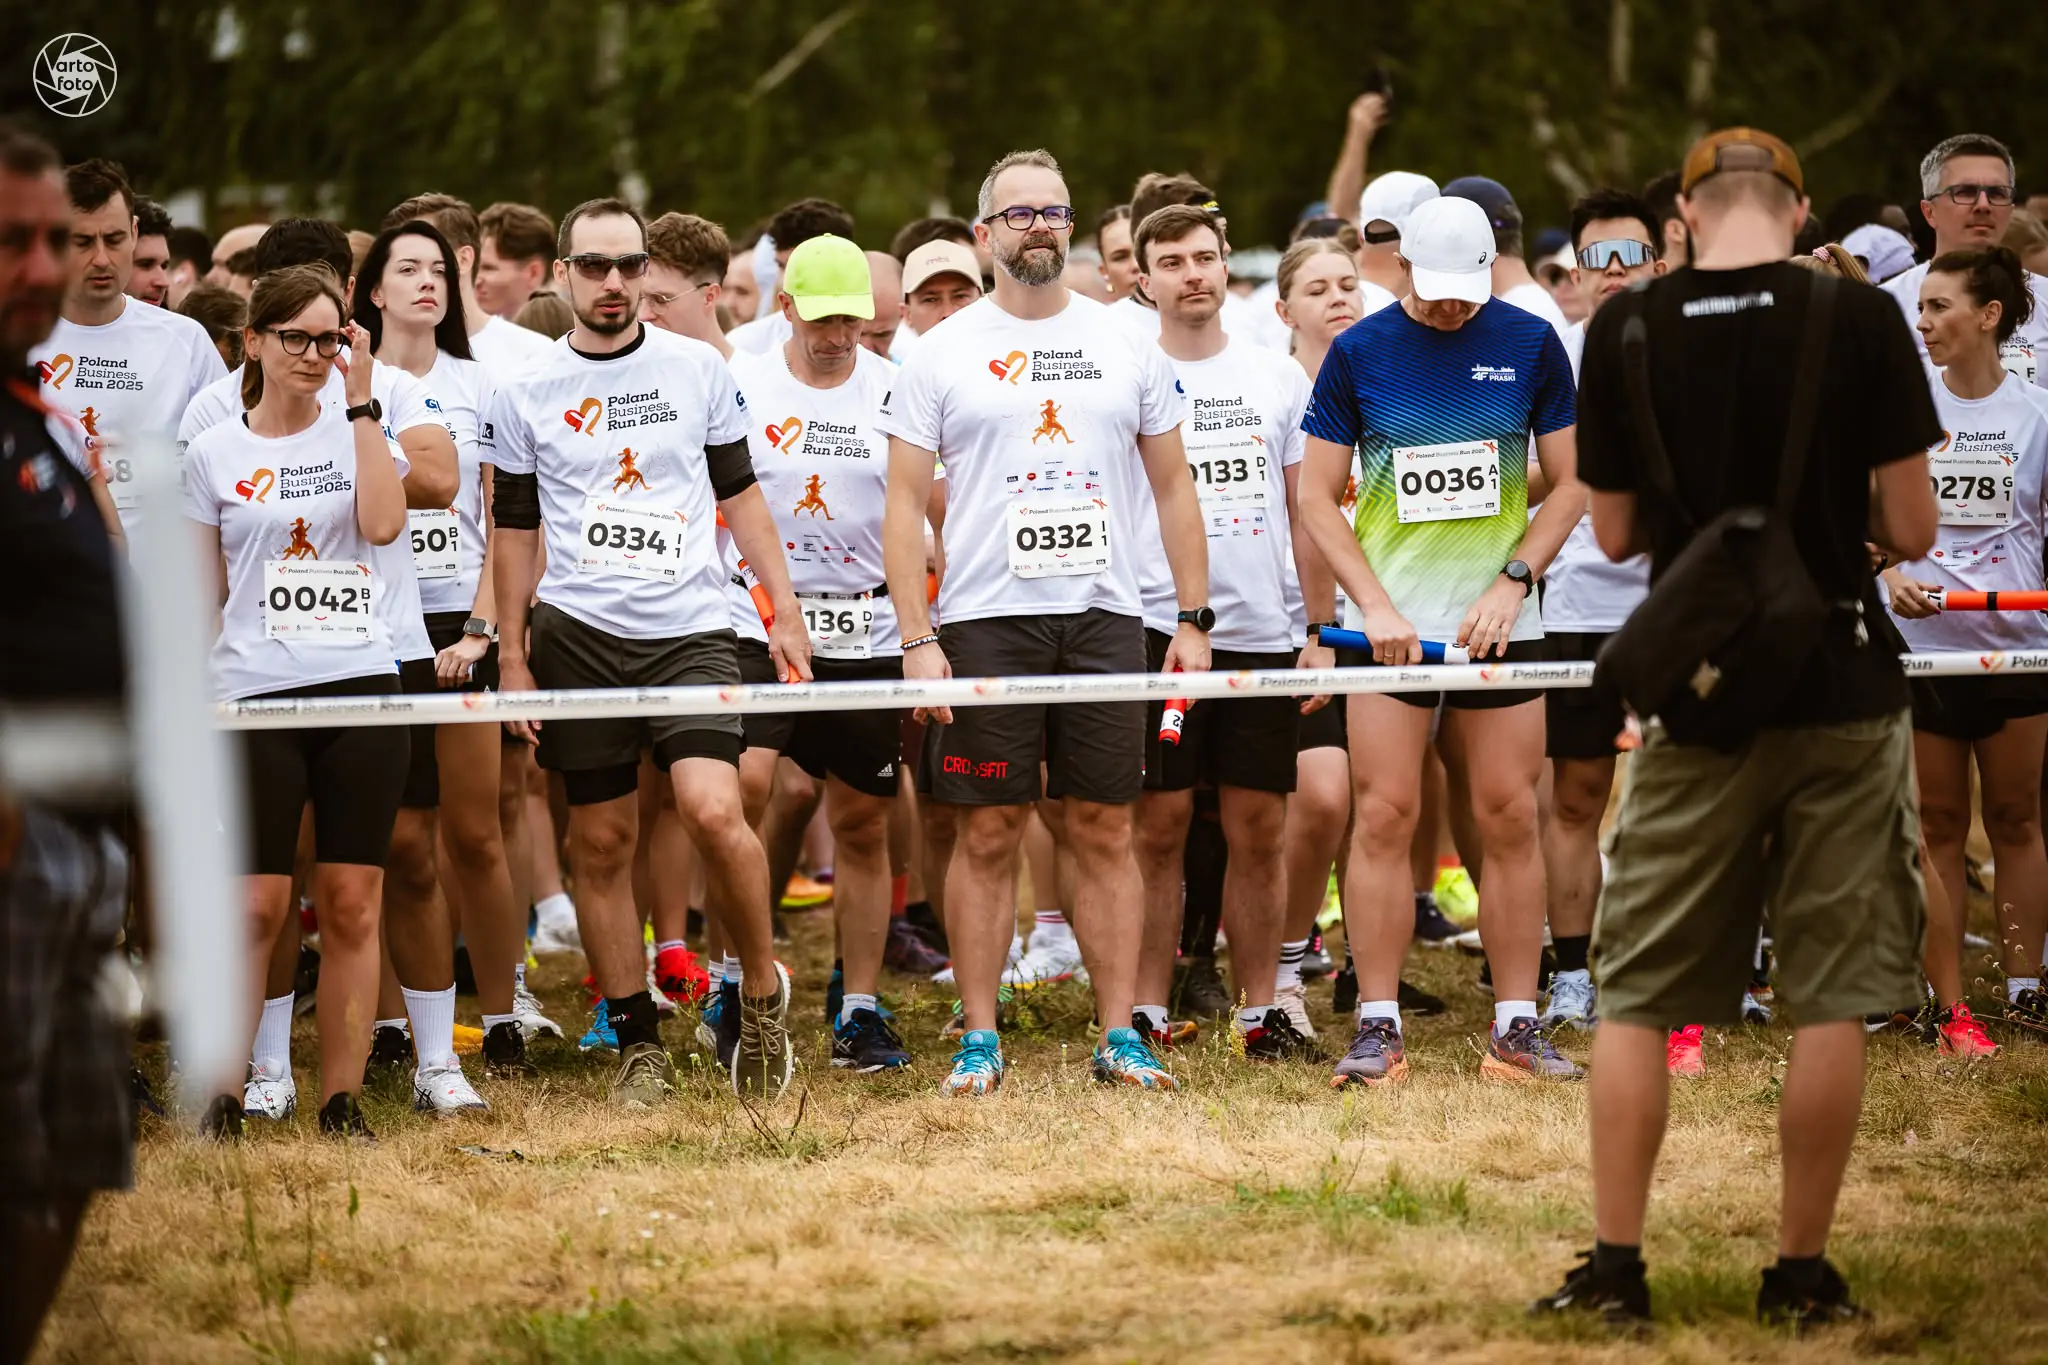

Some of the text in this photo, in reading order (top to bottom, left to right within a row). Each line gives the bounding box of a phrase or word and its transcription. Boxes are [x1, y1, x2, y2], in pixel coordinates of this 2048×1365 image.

[1032, 349, 1083, 360] Poland
[78, 355, 128, 369] Poland
[1032, 360, 1094, 371] Business
[76, 367, 137, 380] Business
[1031, 369, 1102, 382] Run 2025
[2027, 367, 2035, 378] F
[74, 378, 144, 391] Run 2025
[607, 389, 660, 407] Poland
[1194, 396, 1243, 410] Poland
[608, 401, 670, 419] Business
[1194, 407, 1254, 421] Business
[607, 410, 678, 431] Run 2025
[1194, 415, 1262, 432] Run 2025
[807, 421, 856, 435] Poland
[805, 433, 865, 447] Business
[1956, 430, 2006, 442] Poland
[802, 443, 871, 459] Run 2025
[1953, 442, 2014, 452] Business
[1257, 456, 1266, 467] D
[279, 461, 334, 477] Poland
[1259, 470, 1265, 481] 1
[280, 471, 344, 489] Business
[1401, 464, 1498, 496] 0036 A
[1491, 479, 1496, 490] 1
[2003, 476, 2013, 488] G
[279, 480, 352, 500] Run 2025
[2004, 490, 2010, 501] 1
[411, 527, 458, 553] 60 B
[588, 522, 667, 555] 0334
[1016, 523, 1093, 552] 0332
[1101, 535, 1107, 546] 1
[451, 541, 456, 551] 1
[675, 547, 681, 558] 1
[269, 586, 371, 613] 0042 B
[363, 603, 369, 614] 1
[804, 610, 872, 634] 136 D
[864, 624, 870, 635] 1
[1512, 667, 1570, 681] Poland
[2011, 655, 2048, 668] Pola
